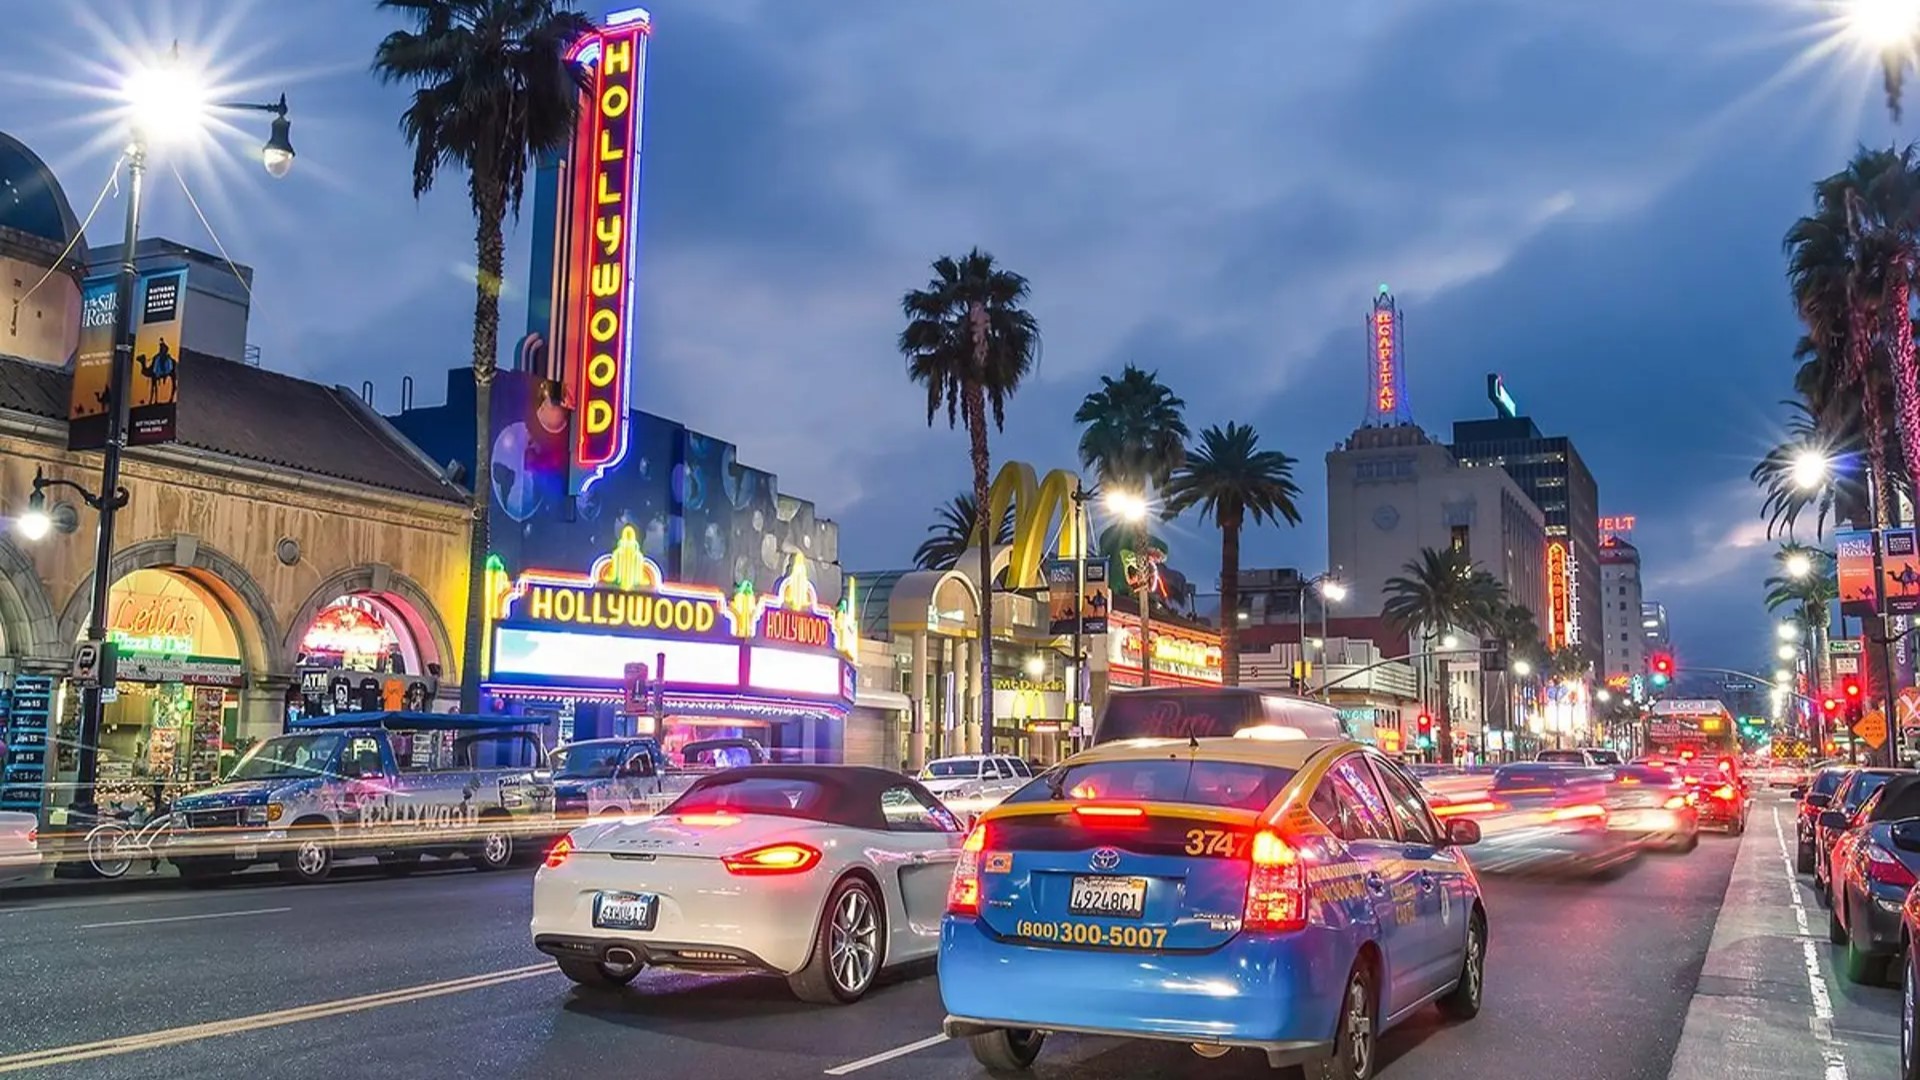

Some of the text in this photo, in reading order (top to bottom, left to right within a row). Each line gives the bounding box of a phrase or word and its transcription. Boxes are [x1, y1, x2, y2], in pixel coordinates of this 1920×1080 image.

[586, 40, 630, 433] HOLLYWOOD
[1378, 325, 1393, 410] CAPITAN
[112, 598, 195, 638] Leila's
[532, 587, 714, 632] HOLLYWOOD
[766, 612, 828, 646] HOLLYWOOD
[303, 673, 328, 688] ATM
[1669, 701, 1706, 710] Local
[360, 802, 479, 829] HOLLYWOOD
[1185, 829, 1248, 857] 3747
[1073, 890, 1136, 911] 49248C1
